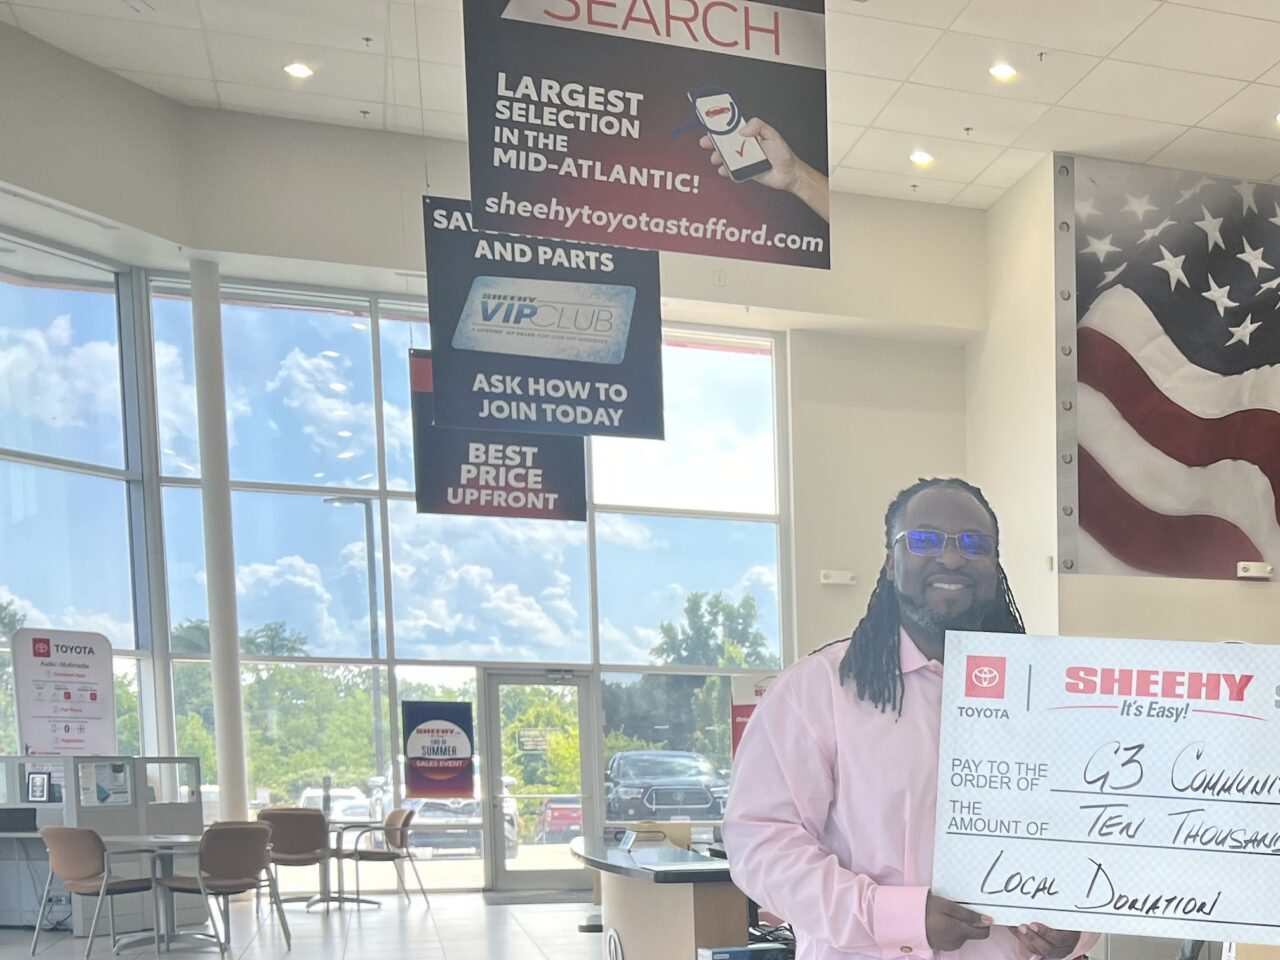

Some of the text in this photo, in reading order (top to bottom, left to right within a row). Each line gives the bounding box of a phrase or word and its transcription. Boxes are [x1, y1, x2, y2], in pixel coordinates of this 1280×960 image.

[497, 72, 644, 116] LARGEST
[495, 100, 640, 138] SELECTION
[494, 126, 568, 152] IN THE
[493, 147, 700, 194] MID-ATLANTIC!
[485, 192, 824, 252] sheehytoyotastafford.com
[474, 240, 532, 262] AND
[538, 246, 614, 272] PARTS
[472, 373, 628, 402] ASK HOW TO
[479, 399, 624, 427] JOIN TODAY
[468, 443, 538, 467] BEST
[460, 464, 543, 489] PRICE
[447, 487, 558, 510] UPFRONT
[54, 644, 95, 656] TOYOTA
[1064, 666, 1254, 703] SHEEHY
[957, 706, 1010, 720] TOYOTA
[1120, 700, 1189, 723] It's Easy!
[421, 745, 457, 756] SUMMER
[951, 758, 1048, 778] PAY TO THE
[1083, 740, 1145, 794] G3
[951, 773, 1039, 792] ORDER OF
[949, 800, 983, 817] THE
[1080, 804, 1146, 839] TEN
[948, 816, 1049, 836] AMOUNT OF
[980, 850, 1059, 897] LOCAL
